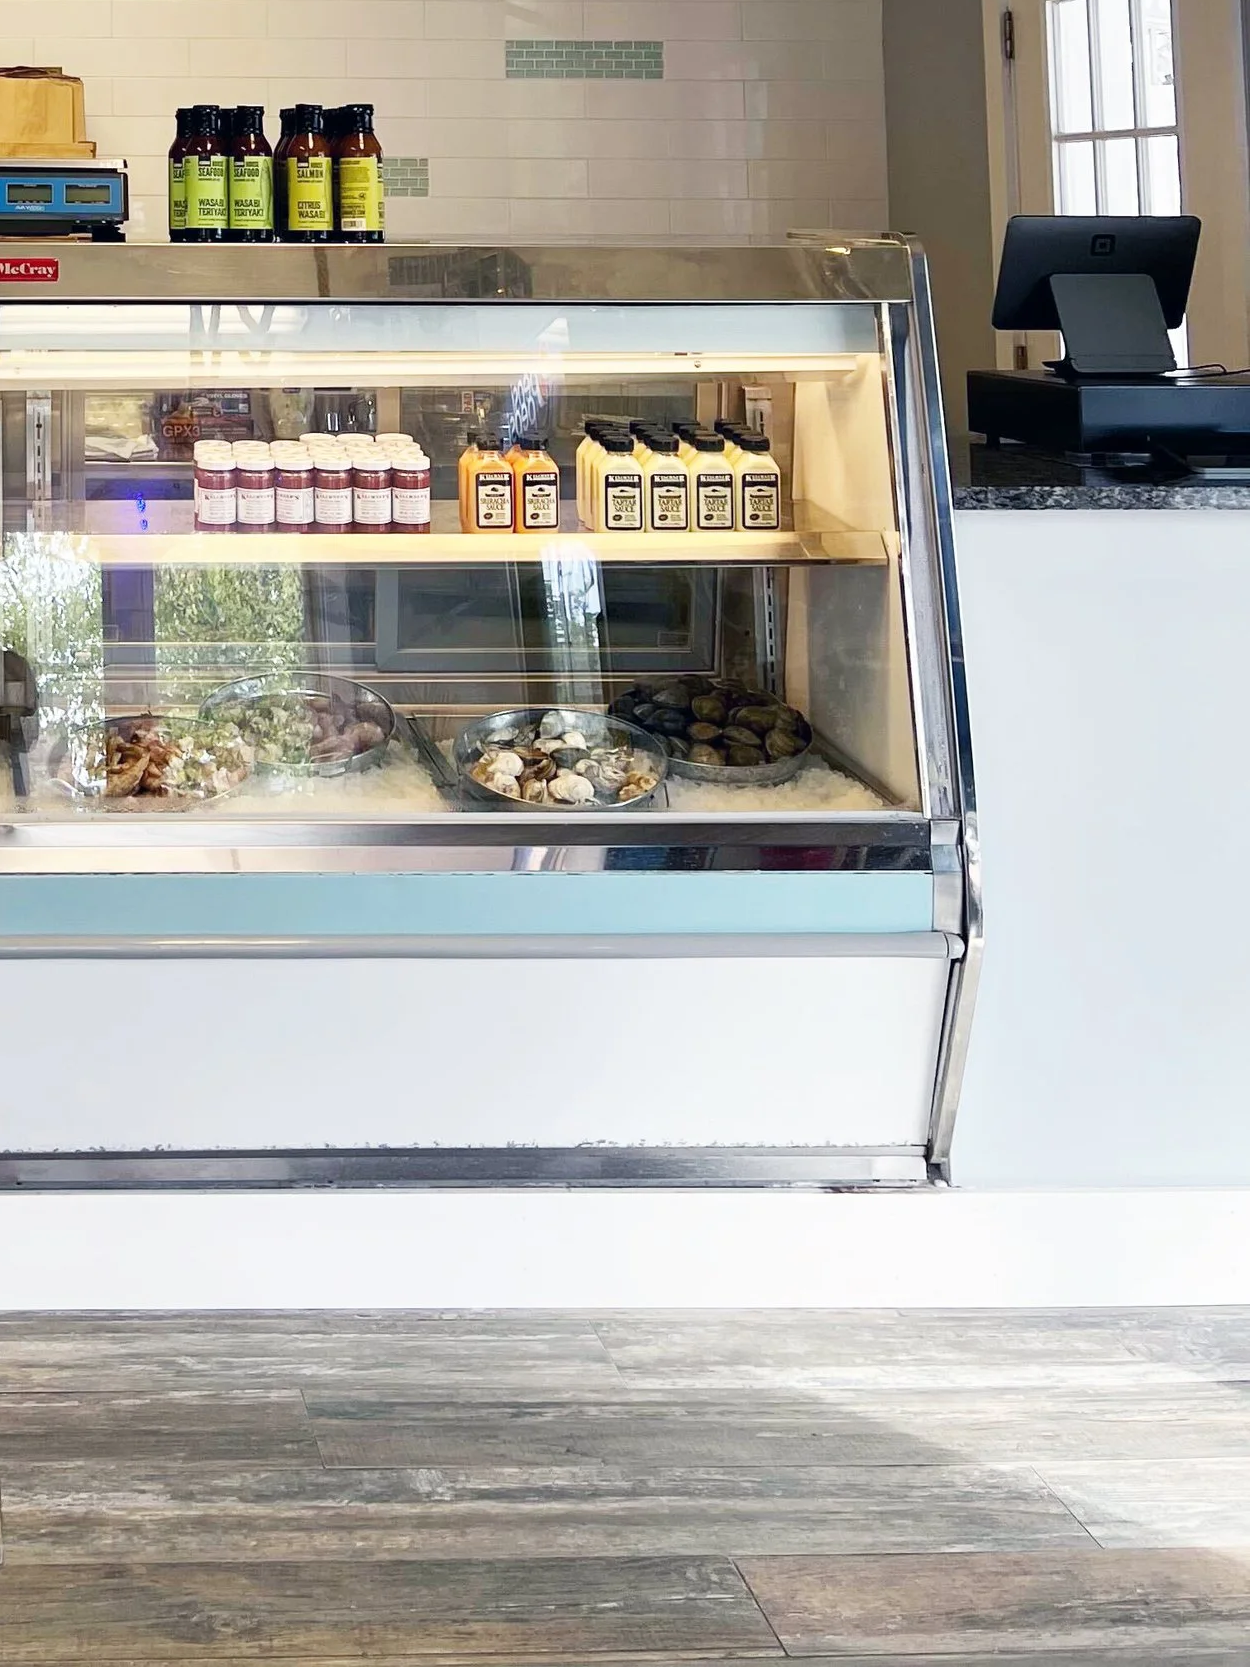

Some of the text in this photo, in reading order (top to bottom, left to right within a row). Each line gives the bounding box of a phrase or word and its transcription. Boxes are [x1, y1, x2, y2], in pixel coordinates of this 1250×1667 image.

[233, 167, 260, 177] SEAFOOD
[297, 169, 324, 178] SALMON
[234, 199, 261, 207] WASABI
[297, 201, 321, 210] CITRUS
[162, 424, 201, 438] GPX3
